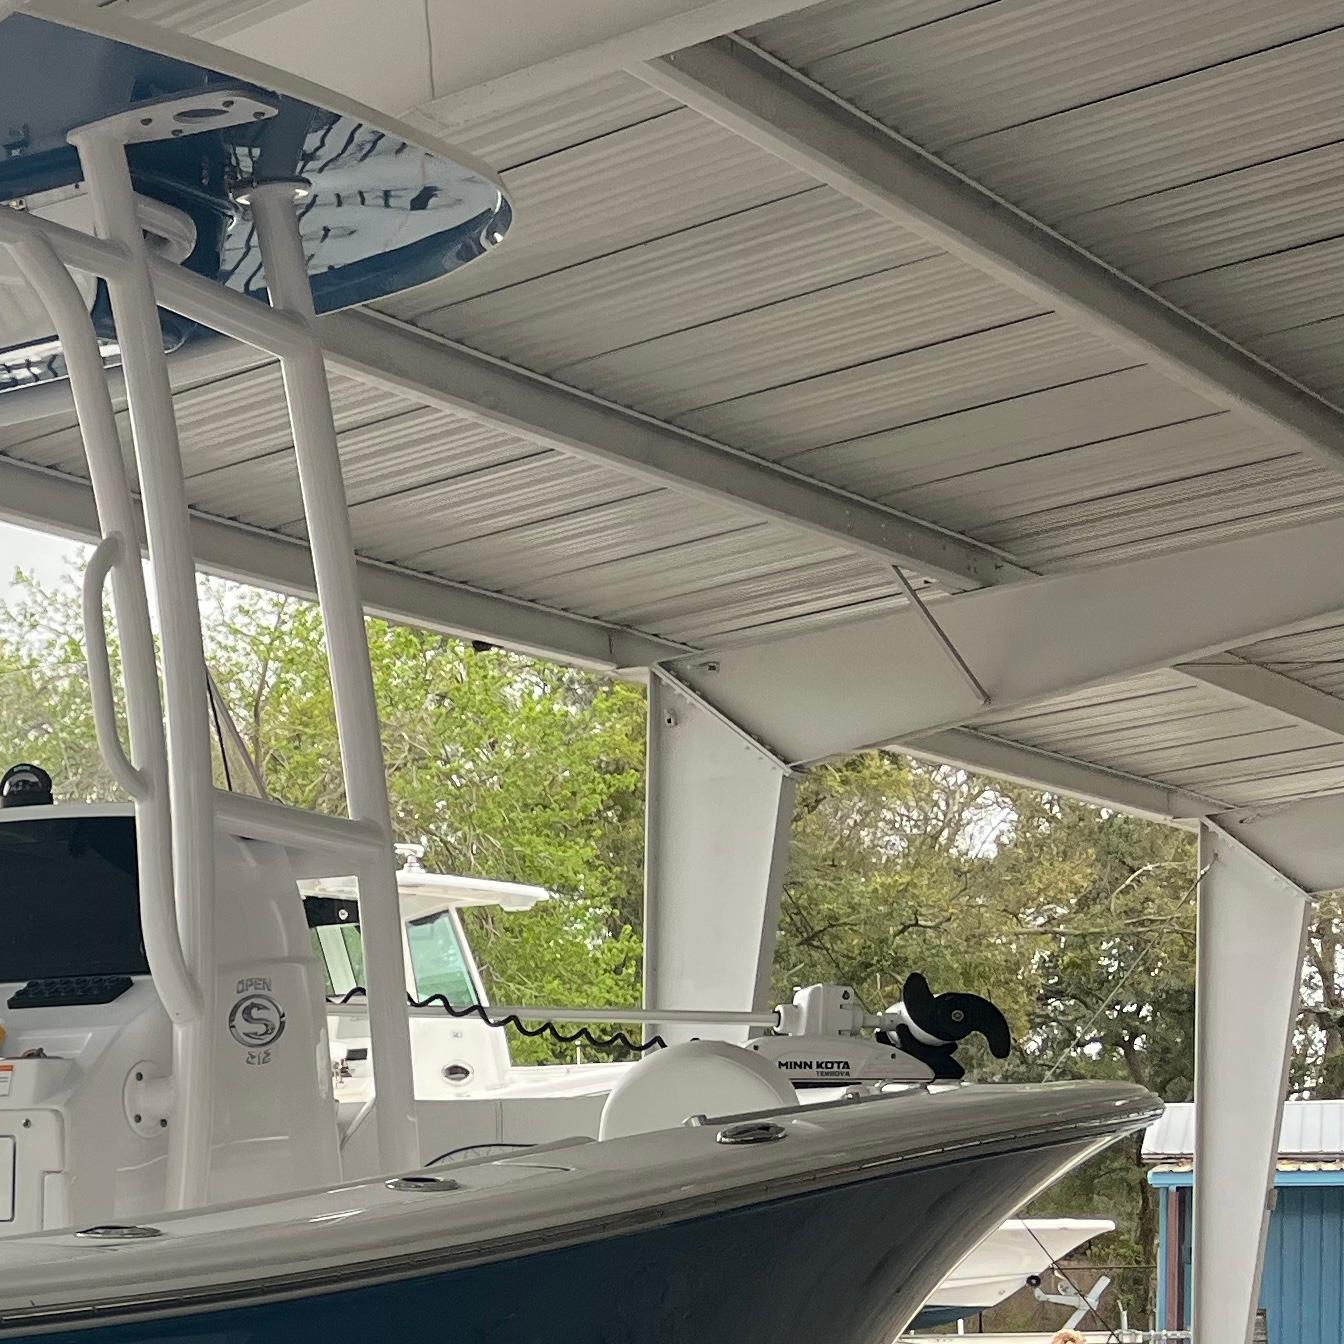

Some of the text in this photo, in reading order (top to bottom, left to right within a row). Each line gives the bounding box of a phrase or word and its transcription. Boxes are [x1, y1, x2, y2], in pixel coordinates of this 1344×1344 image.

[236, 977, 272, 994] OPEN
[778, 1061, 850, 1070] MINN KOTA
